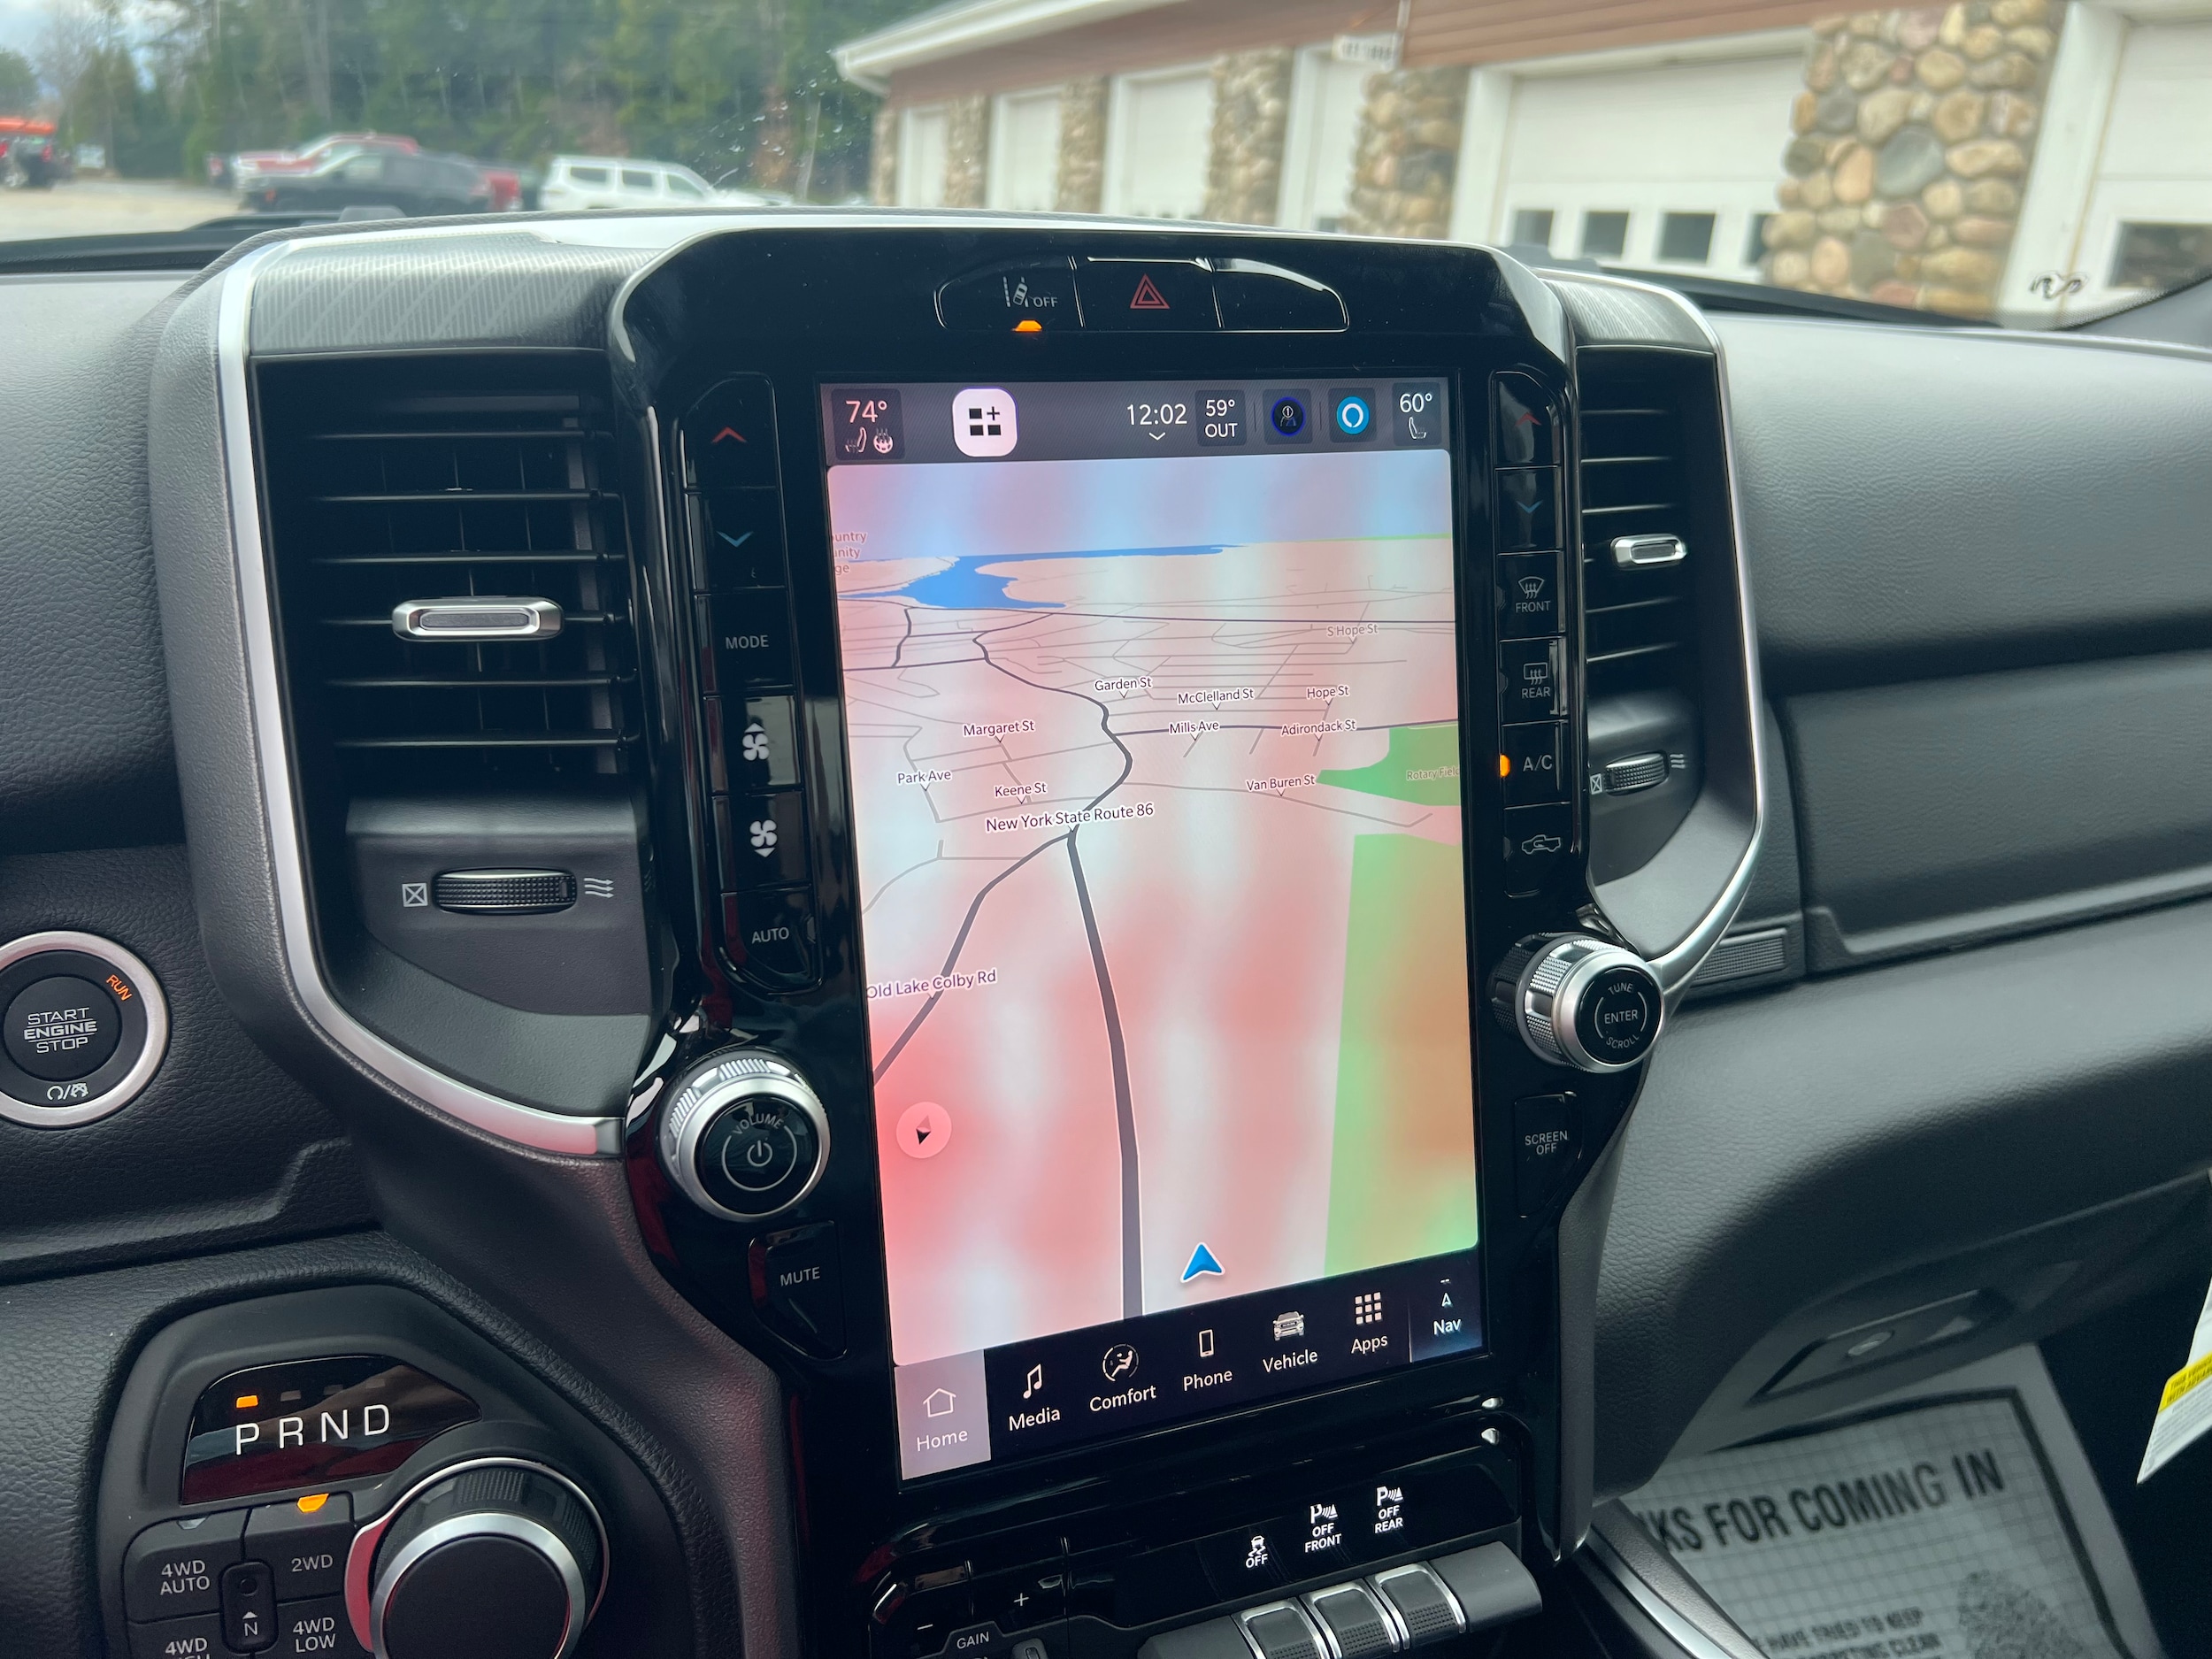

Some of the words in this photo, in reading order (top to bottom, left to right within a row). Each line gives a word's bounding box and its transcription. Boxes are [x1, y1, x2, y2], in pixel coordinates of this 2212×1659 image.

[1033, 296, 1058, 308] OFF
[845, 399, 888, 423] 74°
[1204, 399, 1236, 418] 59°
[1399, 393, 1433, 413] 60°
[1126, 403, 1188, 426] 12:02
[1204, 423, 1238, 438] OUT
[832, 532, 867, 543] untry
[1515, 600, 1551, 613] FRONT
[1327, 626, 1334, 637] S
[1336, 624, 1364, 639] Hope
[1367, 623, 1379, 634] St
[725, 634, 770, 650] MODE
[1094, 679, 1136, 692] Garden
[1140, 677, 1152, 688] St
[1307, 687, 1335, 702] Hope
[1338, 685, 1349, 696] St
[1521, 687, 1551, 699] REAR
[1178, 689, 1240, 705] McClelland
[1242, 688, 1254, 700] St
[963, 721, 1020, 739] Margaret
[1023, 719, 1035, 733] St
[1170, 722, 1195, 734] Mills
[1198, 720, 1219, 733] Ave
[1281, 721, 1341, 736] Adirondack
[1344, 719, 1356, 731] St
[1523, 754, 1553, 772] A/C
[897, 771, 925, 785] Park
[926, 769, 951, 782] Ave
[1247, 779, 1268, 792] Van
[1270, 776, 1301, 789] Buren
[1302, 774, 1315, 786] St
[1407, 770, 1437, 780] Rotary
[995, 784, 1032, 797] Keene
[1034, 782, 1047, 795] St
[986, 817, 1018, 832] New
[1021, 813, 1053, 829] York
[1056, 809, 1091, 825] State
[1094, 805, 1133, 822] Route
[1136, 803, 1154, 817] 86
[751, 926, 790, 944] AUTO
[106, 974, 133, 1001] RUN
[866, 983, 892, 999] Old
[896, 979, 929, 996] Lake
[933, 973, 973, 992] Colby
[977, 969, 996, 985] Rd
[1607, 982, 1634, 996] TUNE
[27, 1008, 90, 1025] START
[1604, 1009, 1639, 1025] ENTER
[23, 1021, 98, 1041] ENGINE
[36, 1036, 88, 1054] STOP
[1606, 1034, 1640, 1049] SCROLL
[732, 1112, 785, 1136] VOLUME
[1525, 1130, 1569, 1147] SCREEN
[1535, 1142, 1557, 1156] OFF
[780, 1266, 821, 1286] MUTE
[1433, 1317, 1462, 1336] Nav
[1350, 1334, 1388, 1355] Apps
[1262, 1348, 1318, 1373] Vehicle
[1183, 1369, 1233, 1392] Phone
[1089, 1385, 1156, 1412] Comfort
[1009, 1407, 1061, 1432] Media
[235, 1422, 260, 1455] P
[279, 1416, 304, 1449] R
[320, 1409, 349, 1443] N
[364, 1403, 390, 1436] D
[917, 1429, 968, 1452] Home
[1704, 1495, 1792, 1547] FOR
[1788, 1462, 1946, 1533] COMING
[1952, 1448, 2004, 1501] IN
[1378, 1504, 1401, 1520] OFF
[1312, 1522, 1335, 1538] OFF
[1374, 1517, 1404, 1534] REAR
[1304, 1532, 1342, 1553] FRONT
[161, 1559, 206, 1578] 4WD
[290, 1554, 334, 1572] 2WD
[1245, 1553, 1269, 1569] OFF
[159, 1575, 211, 1596] AUTO
[243, 1621, 258, 1637] N
[292, 1616, 335, 1636] 4WD
[165, 1636, 209, 1656] 4WD
[295, 1633, 336, 1653] LOW
[956, 1631, 990, 1650] GAIN
